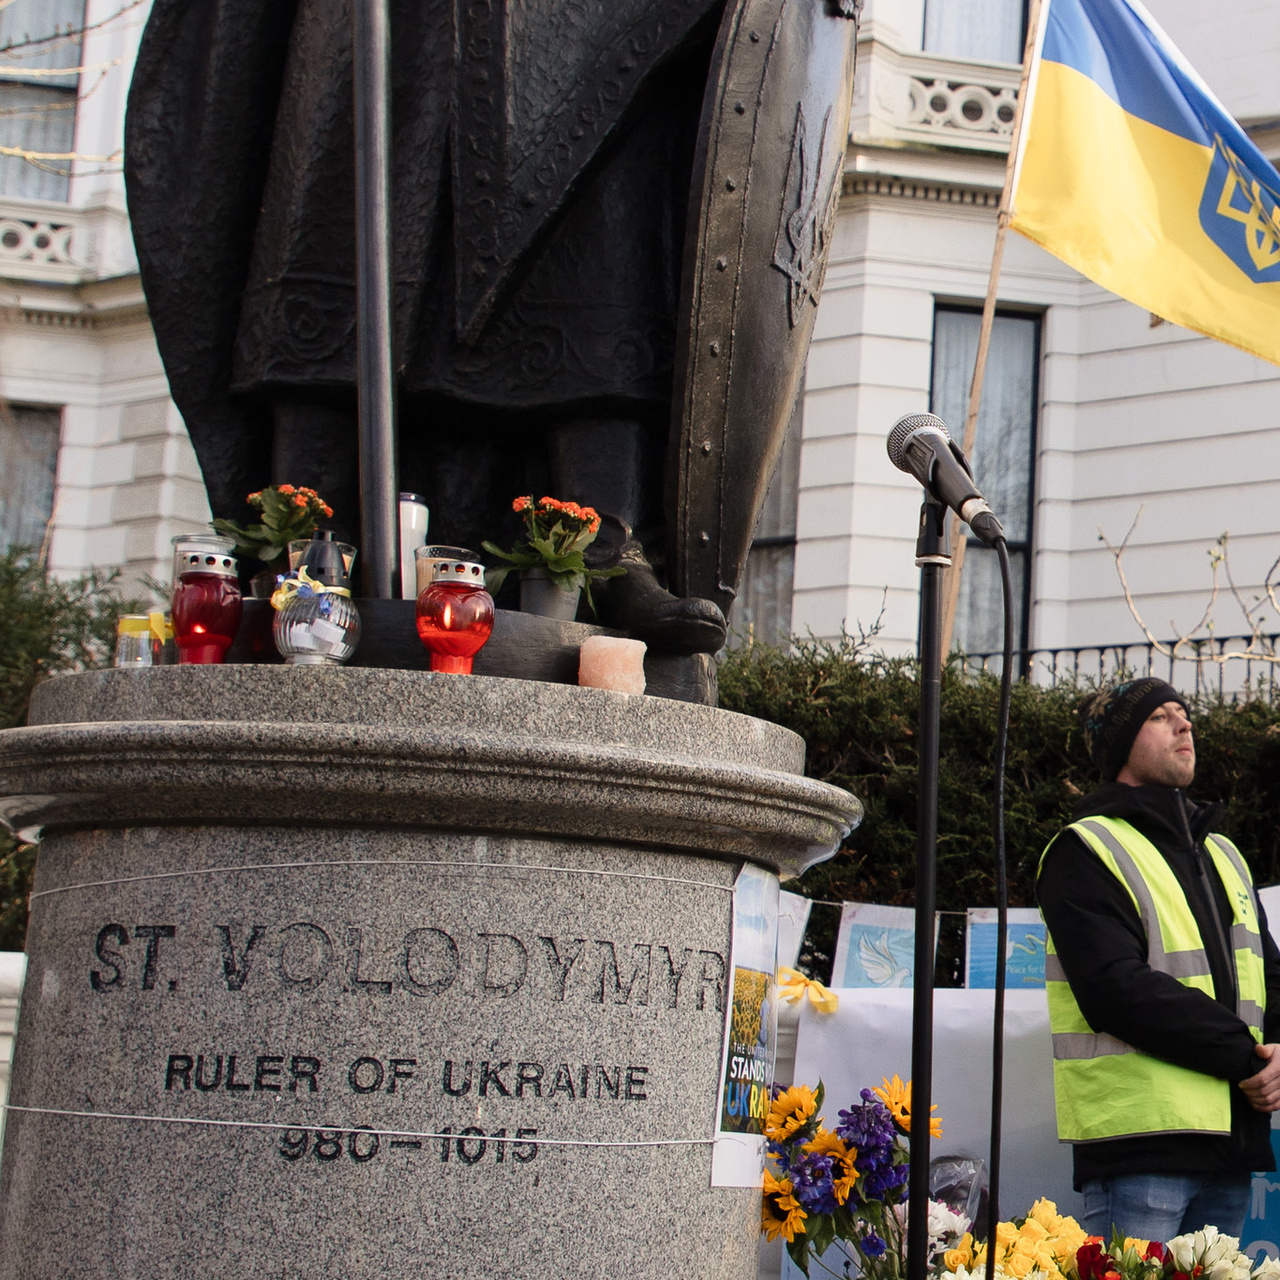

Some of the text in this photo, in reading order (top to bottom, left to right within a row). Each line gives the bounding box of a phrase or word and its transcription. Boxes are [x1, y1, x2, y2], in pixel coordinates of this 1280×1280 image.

[90, 922, 727, 1012] ST. VOLODYMYR
[164, 1054, 650, 1101] RULER OF UKRAINE
[730, 1055, 765, 1083] STANDS
